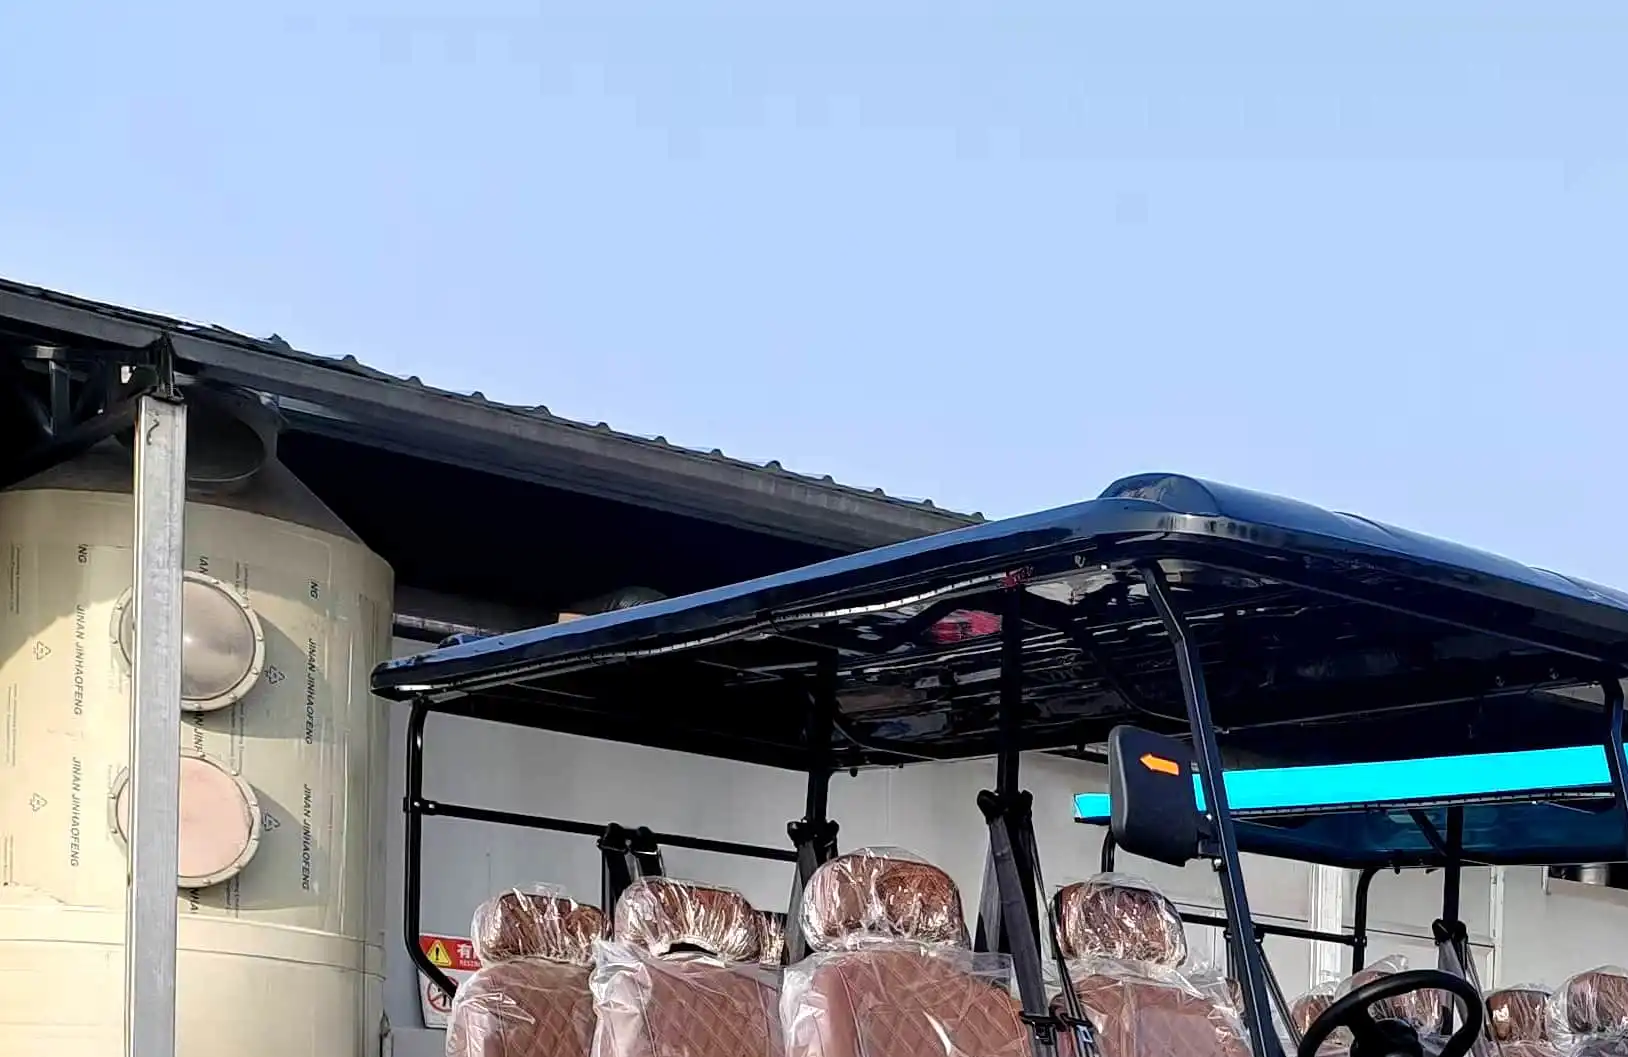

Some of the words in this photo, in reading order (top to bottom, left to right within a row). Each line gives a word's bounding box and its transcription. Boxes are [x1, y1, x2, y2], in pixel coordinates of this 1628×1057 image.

[76, 604, 86, 640] JINAN
[308, 638, 318, 672] JINAN
[74, 642, 84, 716] JINHAOFENG
[72, 756, 81, 792] JINAN
[304, 784, 312, 818] JINAN
[70, 794, 80, 867] JINHAOFENG
